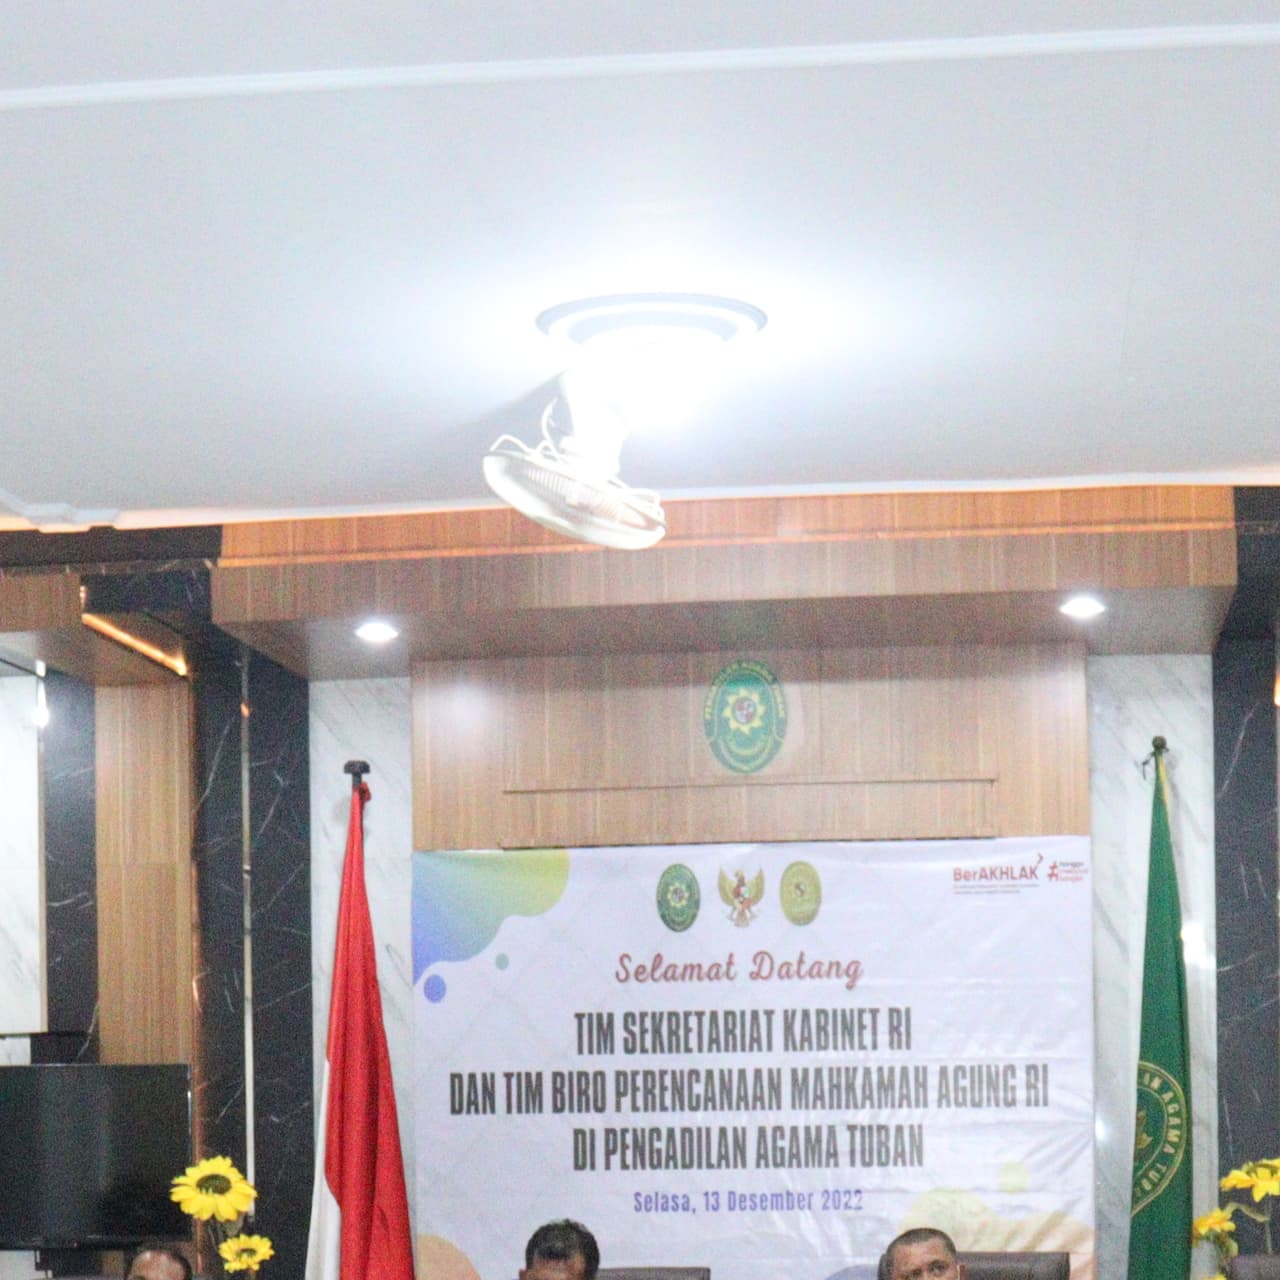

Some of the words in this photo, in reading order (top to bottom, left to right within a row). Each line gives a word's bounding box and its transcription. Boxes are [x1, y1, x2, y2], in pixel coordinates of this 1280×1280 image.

[953, 866, 1039, 881] BerAKHLAK
[615, 952, 736, 983] Selamat
[749, 950, 863, 990] Datang
[574, 1012, 615, 1055] TIM
[623, 1009, 775, 1054] SEKRETARIAT
[783, 1008, 880, 1052] KABINET
[888, 1007, 912, 1050] RI
[450, 1072, 496, 1115] DAN
[503, 1071, 543, 1114] TIM
[551, 1070, 607, 1114] BIRO
[615, 1067, 782, 1112] PERENCANAAN
[790, 1065, 928, 1111] MAHKAMAH
[937, 1064, 1017, 1108] AGUNG
[1025, 1063, 1049, 1107] RI
[573, 1128, 596, 1171] DI
[604, 1126, 747, 1171] PENGADILAN
[755, 1125, 839, 1169] AGAMA
[847, 1124, 924, 1168] TUBAN
[633, 1191, 696, 1214] Selasa,
[703, 1191, 720, 1212] 13
[727, 1189, 814, 1212] Desember
[821, 1189, 863, 1211] 2022
